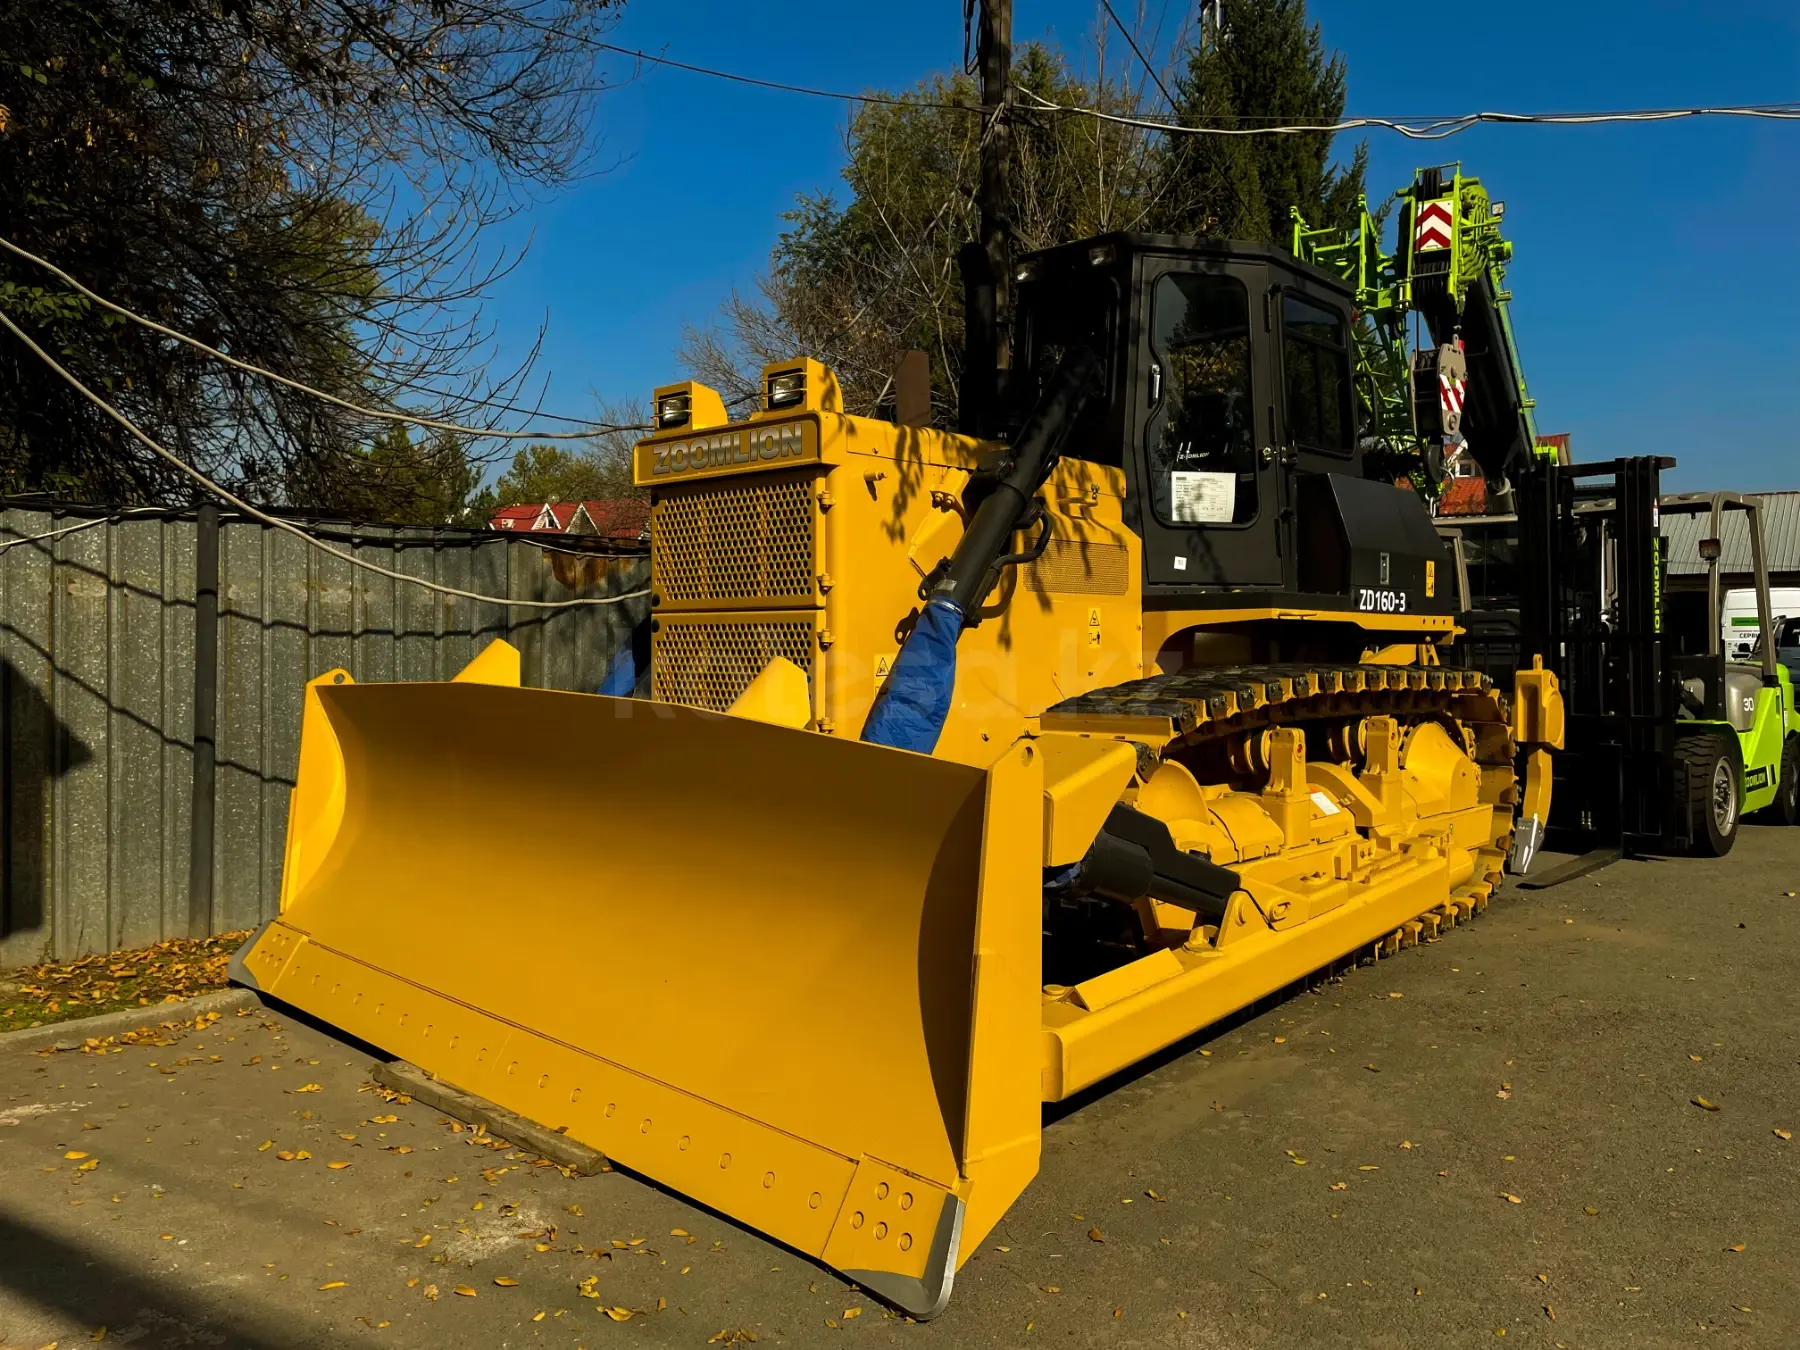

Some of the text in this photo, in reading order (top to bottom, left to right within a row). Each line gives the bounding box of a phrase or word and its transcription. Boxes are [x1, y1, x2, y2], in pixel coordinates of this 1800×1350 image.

[652, 423, 802, 476] ZOOMLION
[1359, 589, 1406, 612] ZD160-3
[1743, 697, 1755, 712] 30
